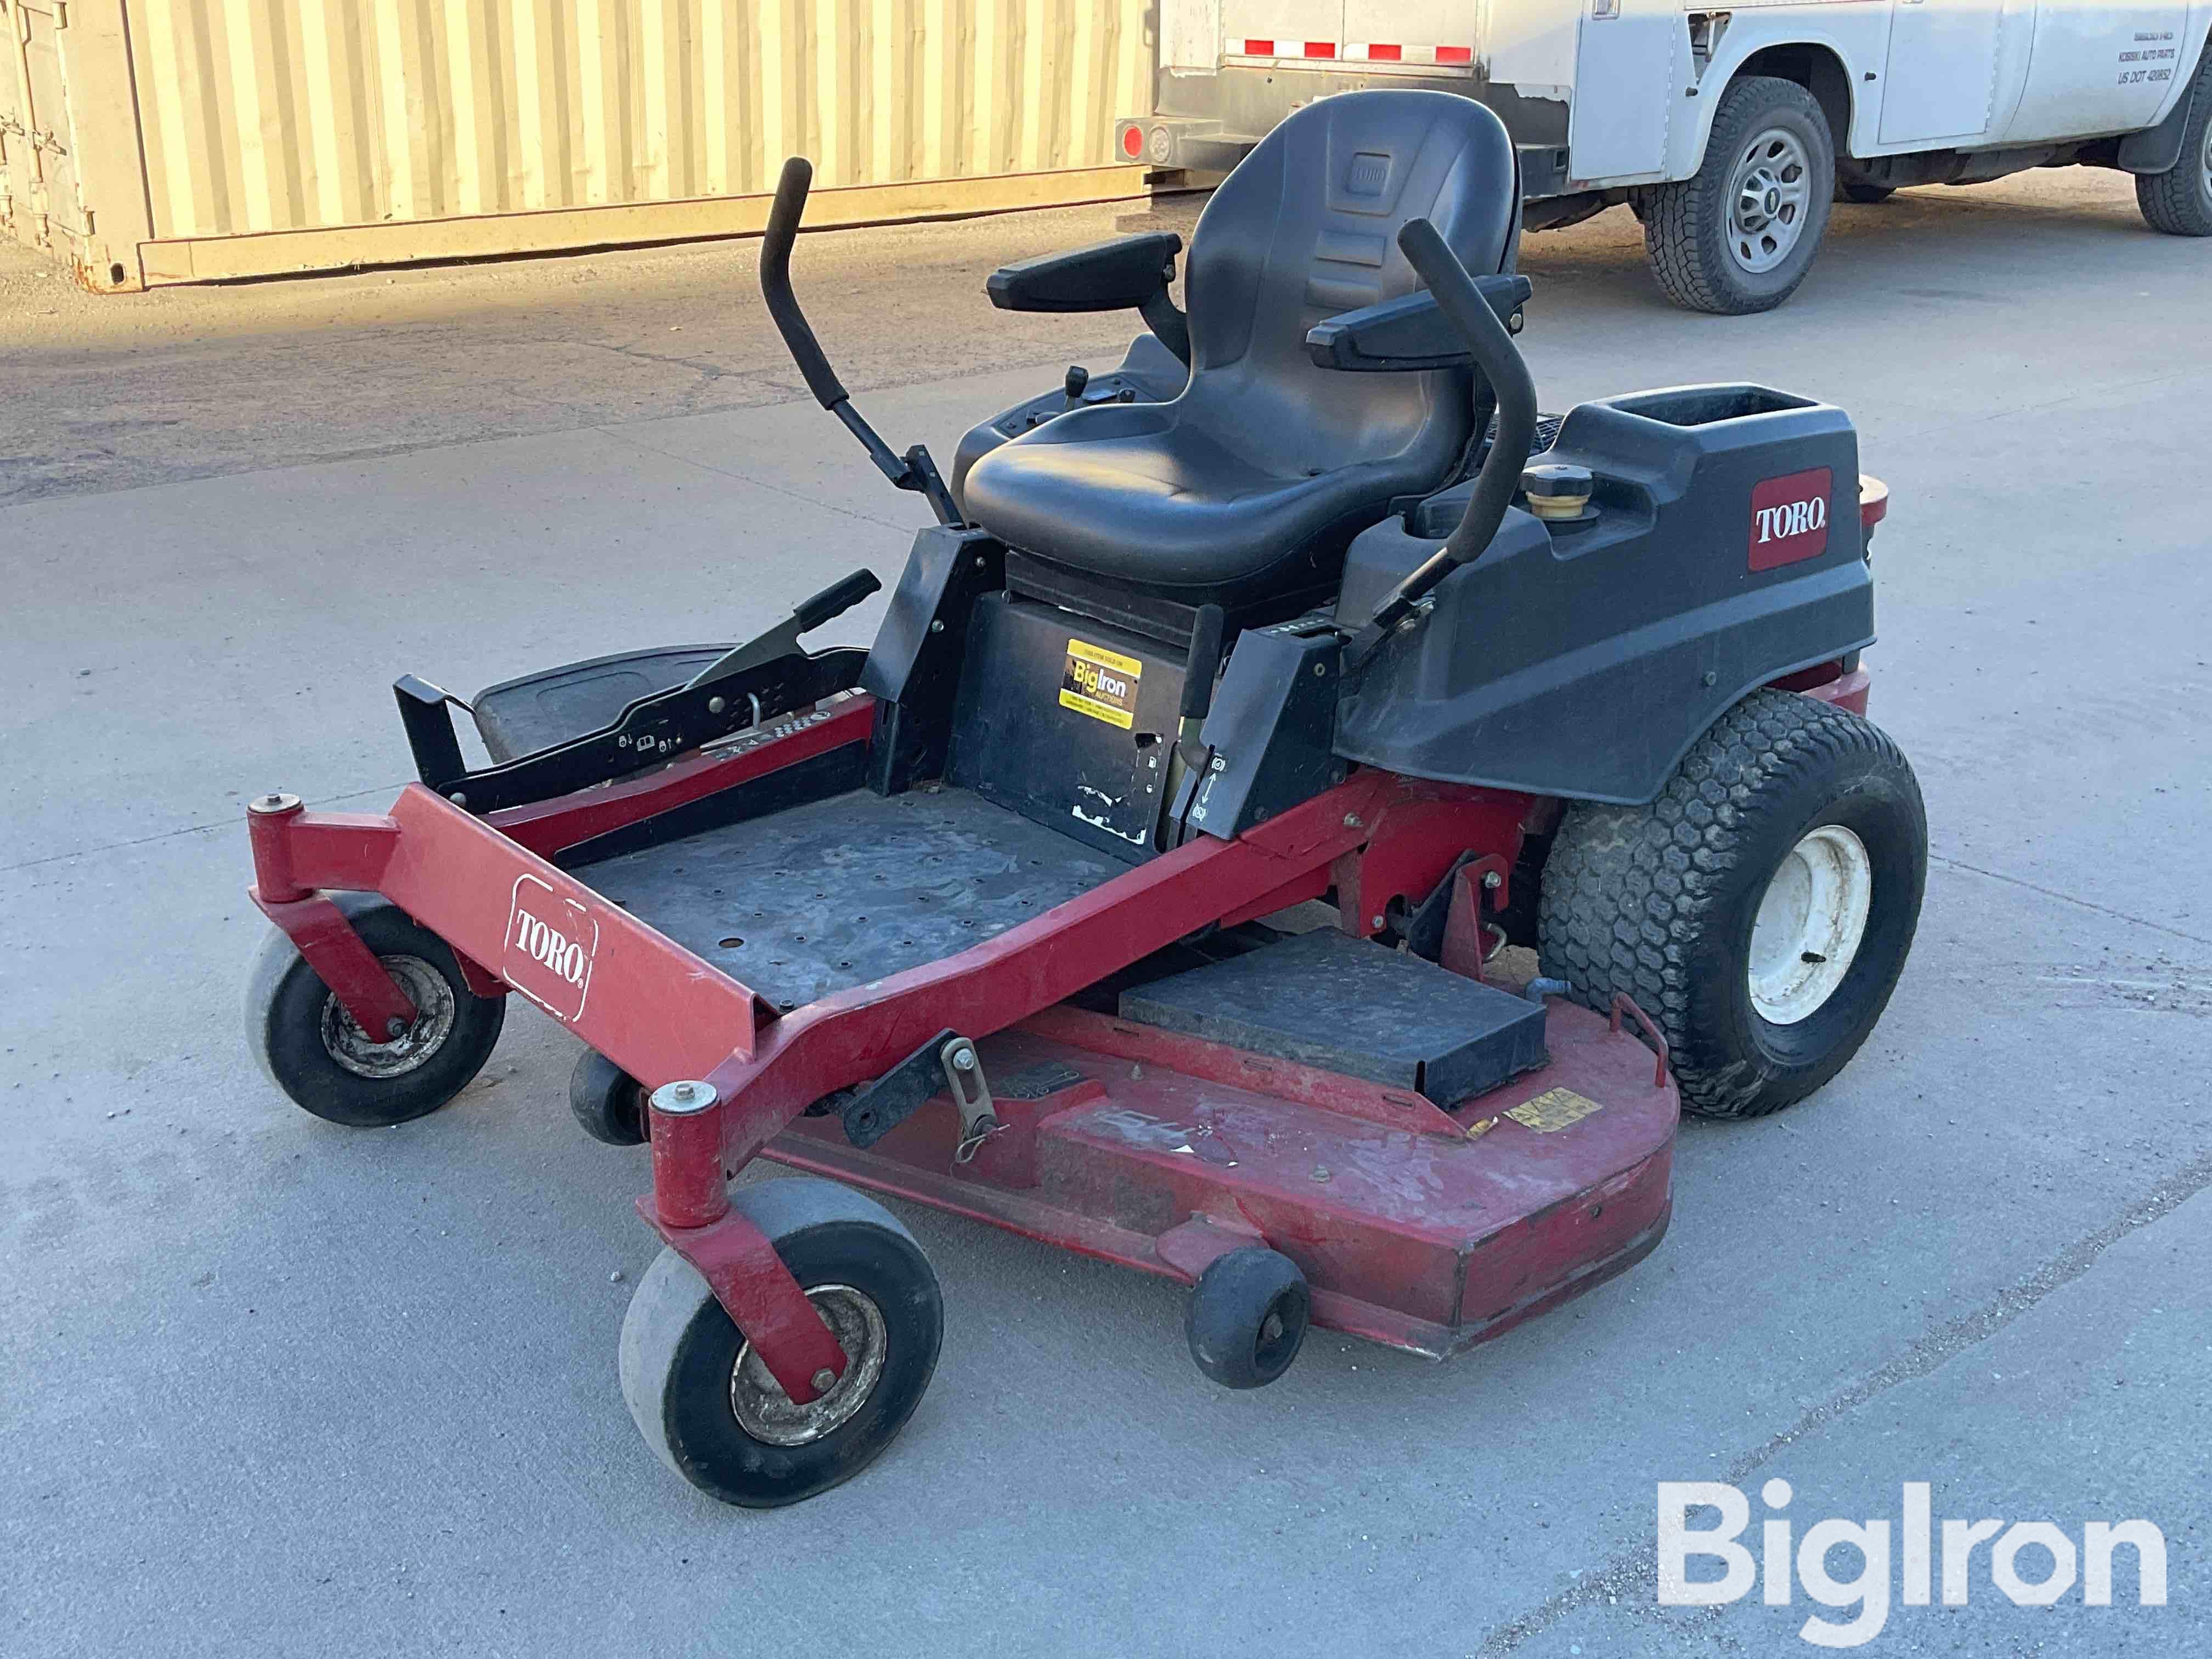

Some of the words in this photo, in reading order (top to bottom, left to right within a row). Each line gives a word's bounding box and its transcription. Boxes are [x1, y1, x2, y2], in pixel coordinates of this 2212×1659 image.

[2142, 50, 2157, 60] AUTO
[2118, 71, 2129, 84] US
[2130, 70, 2146, 83] DOT
[1756, 496, 1825, 543] TORO
[1074, 660, 1126, 698] BigIron
[515, 909, 583, 983] TORO
